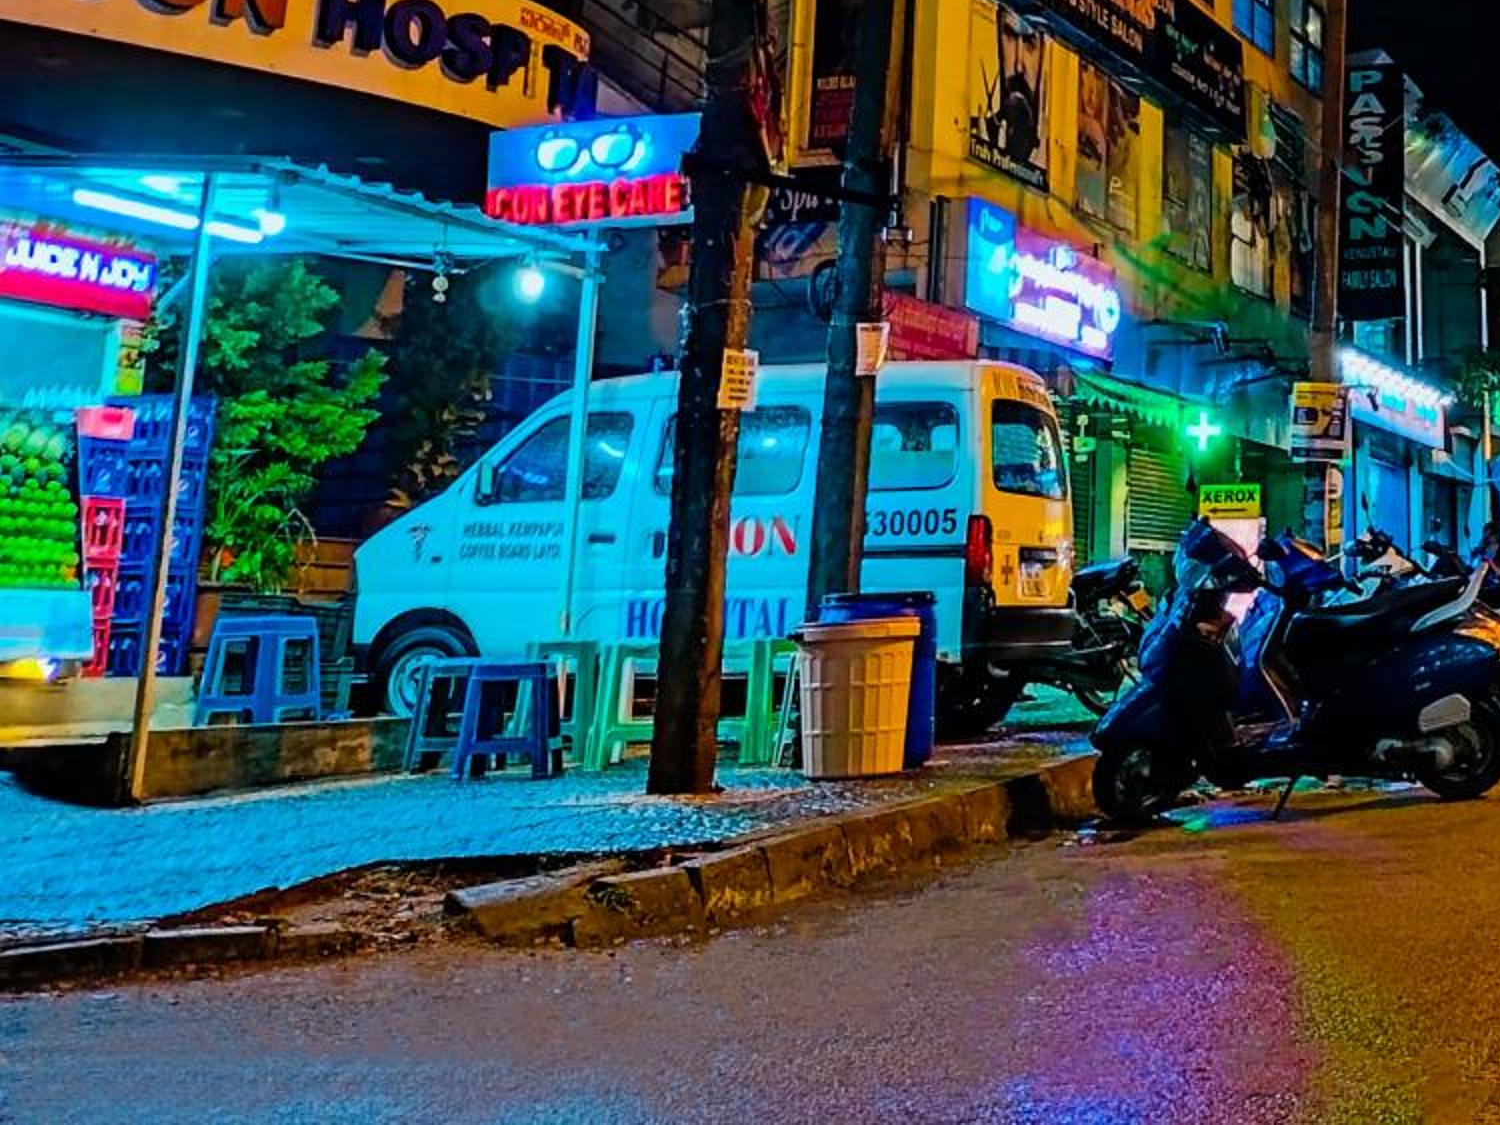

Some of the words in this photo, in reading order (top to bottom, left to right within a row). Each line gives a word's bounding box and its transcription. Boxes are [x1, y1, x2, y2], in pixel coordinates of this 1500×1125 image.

[1111, 14, 1144, 55] SALON
[484, 185, 549, 224] ICON
[551, 181, 607, 225] EYE
[608, 175, 683, 220] CARE
[1202, 489, 1257, 504] XEROX
